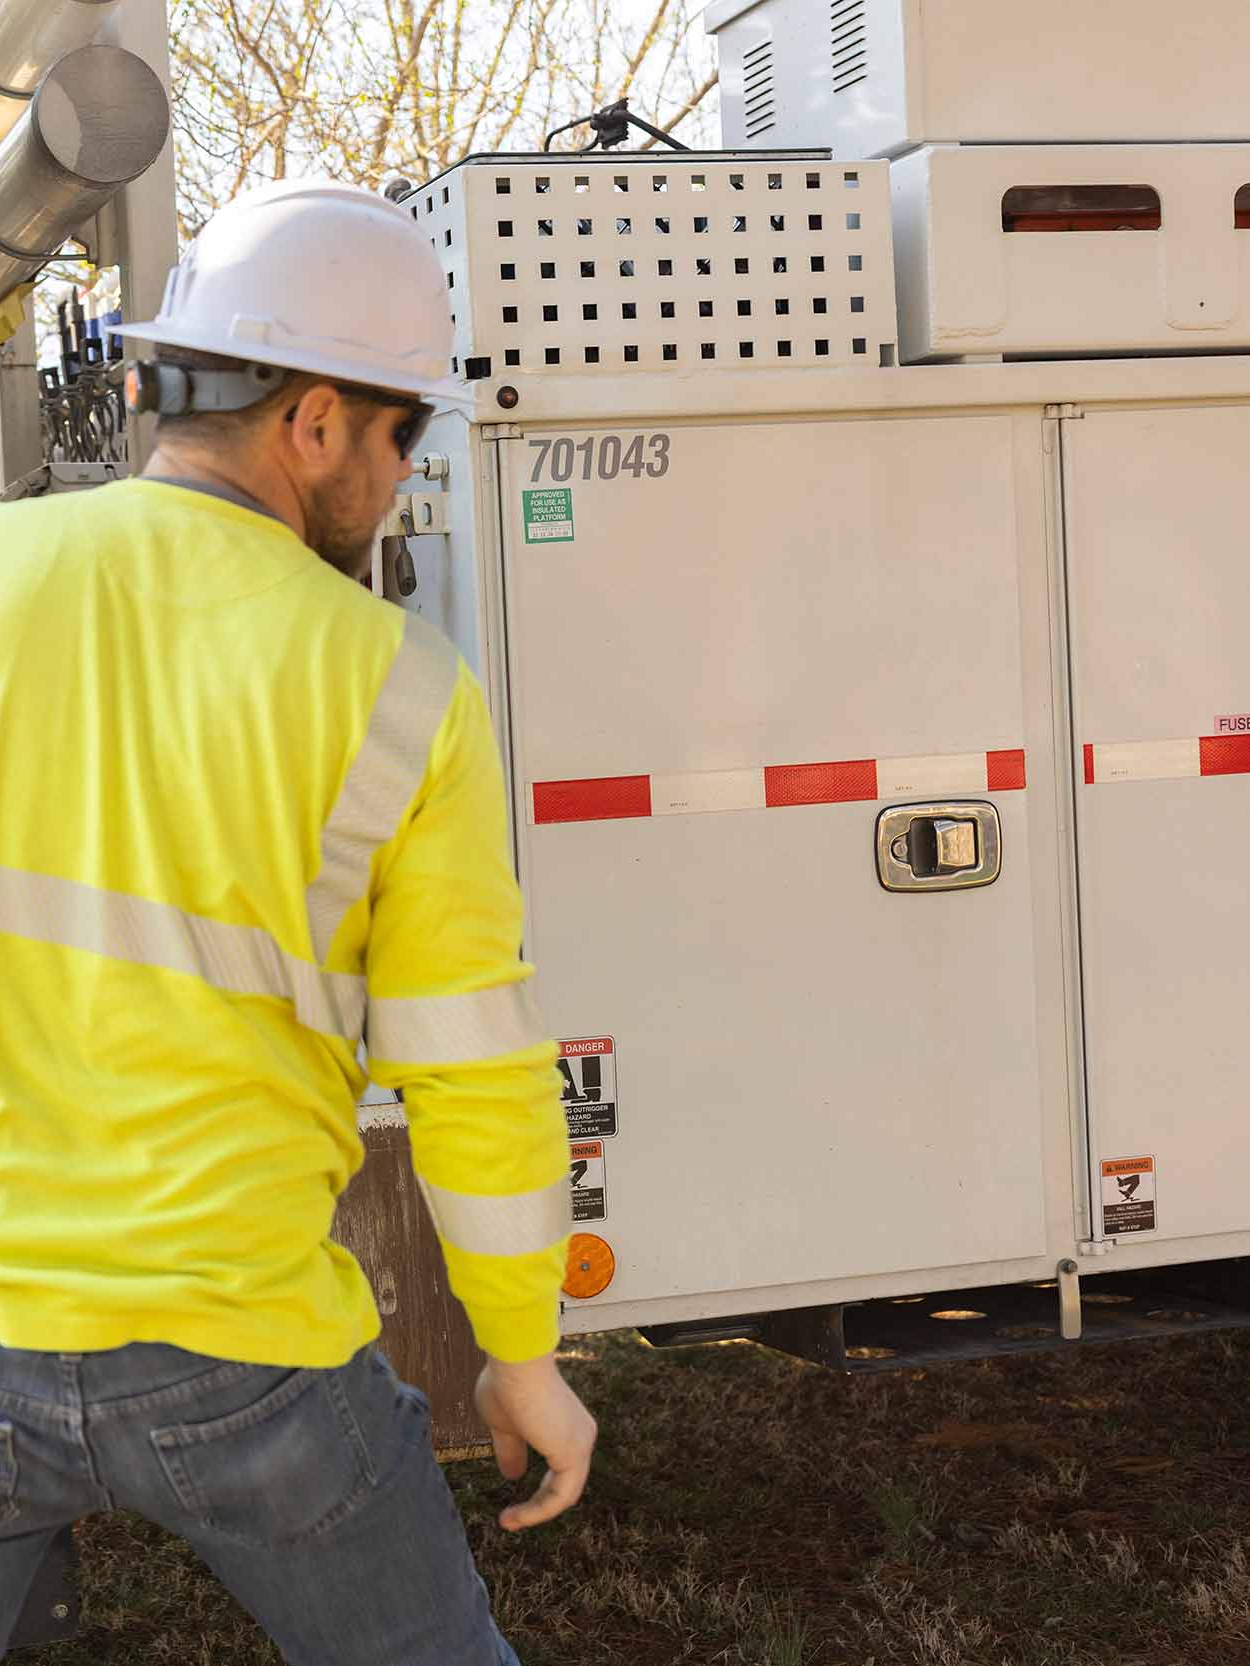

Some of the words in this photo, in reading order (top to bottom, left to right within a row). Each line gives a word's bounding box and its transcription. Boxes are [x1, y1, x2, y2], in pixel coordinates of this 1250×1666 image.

[528, 434, 670, 483] 701043
[532, 491, 565, 499] APPROVED
[530, 499, 544, 507] FOR
[532, 506, 566, 514] INSULATED
[533, 513, 566, 522] PLATFORM
[565, 1042, 605, 1054] DANGER
[573, 1105, 609, 1114] OUTRIGGER
[580, 1126, 600, 1134] CLEAR
[571, 1146, 598, 1156] RNING
[1115, 1162, 1149, 1170] WARNING
